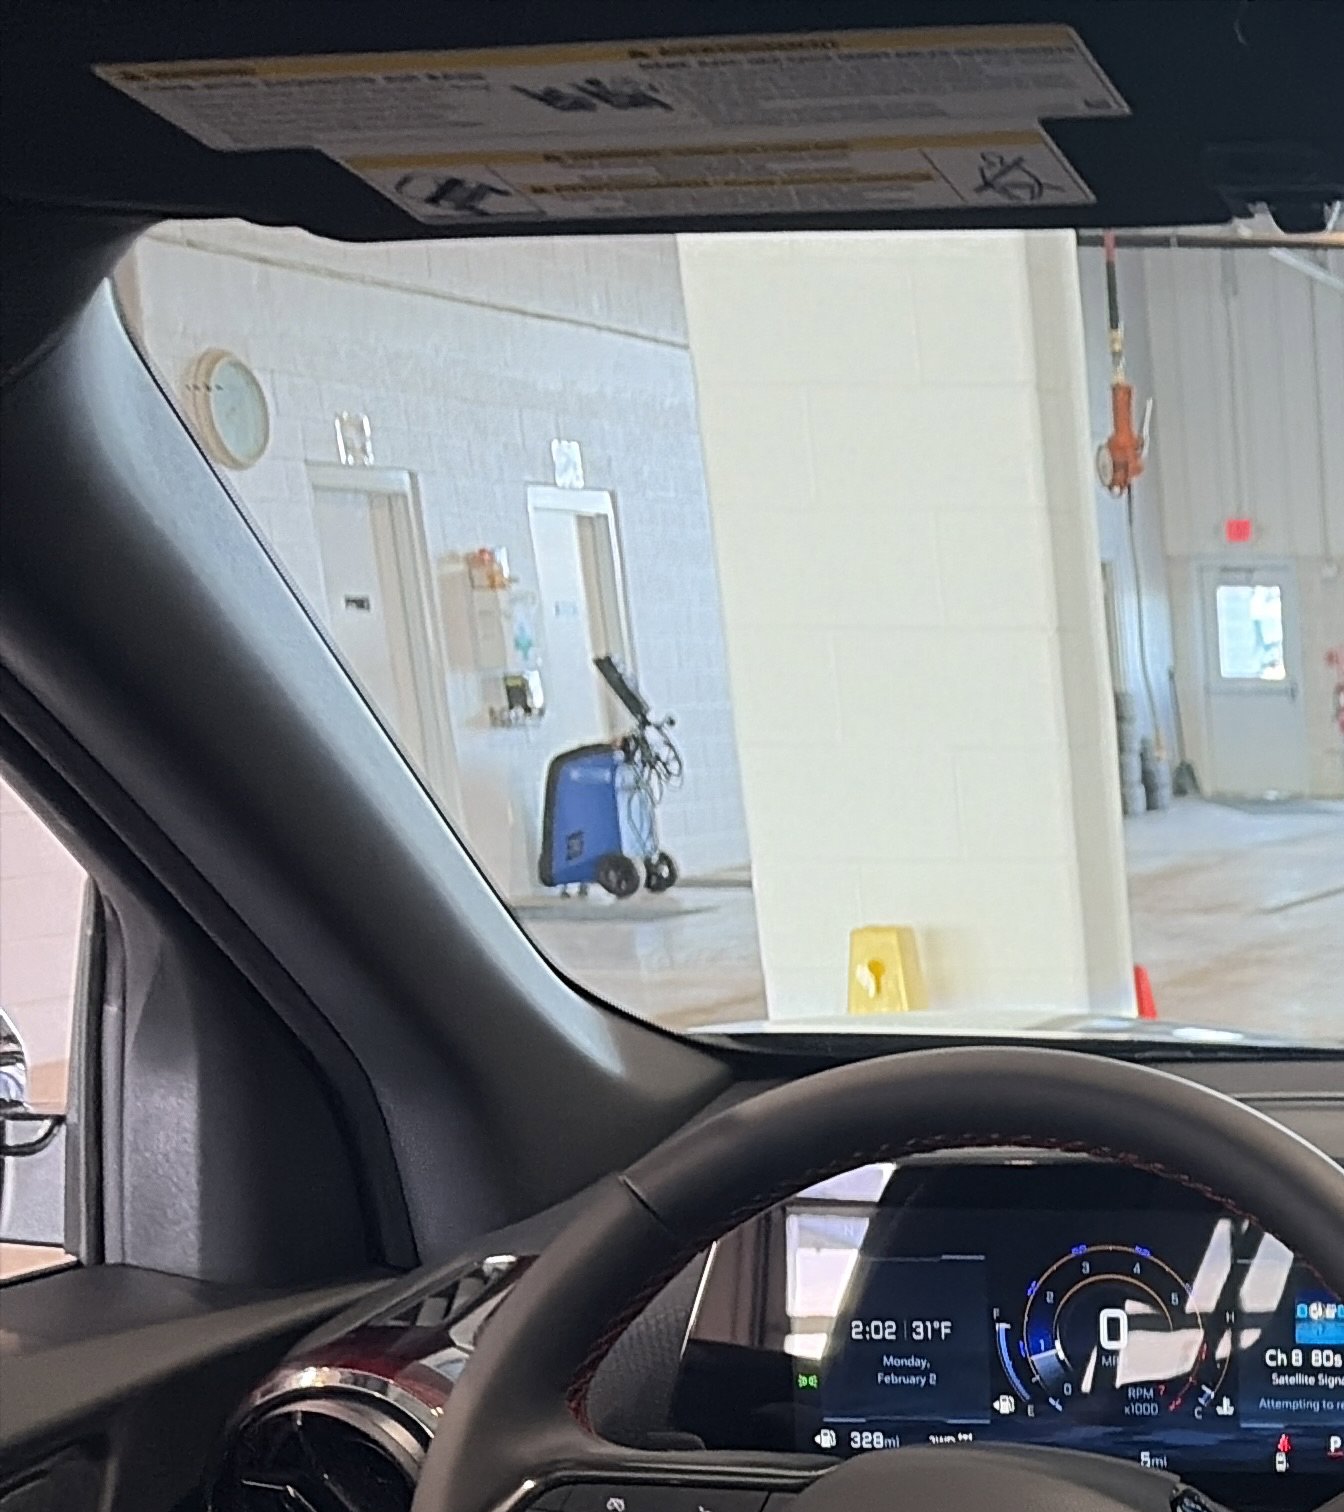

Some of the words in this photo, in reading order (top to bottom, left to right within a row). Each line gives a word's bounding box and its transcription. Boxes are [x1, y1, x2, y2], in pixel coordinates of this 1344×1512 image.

[1081, 1261, 1090, 1275] 3
[1133, 1261, 1142, 1275] 4
[851, 1320, 897, 1341] 2:02
[911, 1320, 952, 1341] 31°F
[1099, 1307, 1128, 1351] 0
[882, 1354, 931, 1369] Monday,
[1264, 1349, 1288, 1368] Ch
[1291, 1349, 1303, 1368] 8
[1311, 1350, 1343, 1369] 80s
[877, 1371, 927, 1388] February
[1271, 1372, 1316, 1387] Satellite
[1062, 1382, 1073, 1396] 0
[1127, 1386, 1155, 1401] RPM
[1124, 1402, 1160, 1417] x1000
[1259, 1397, 1321, 1412] Attempting
[1322, 1398, 1335, 1411] to
[1330, 1435, 1342, 1453] P
